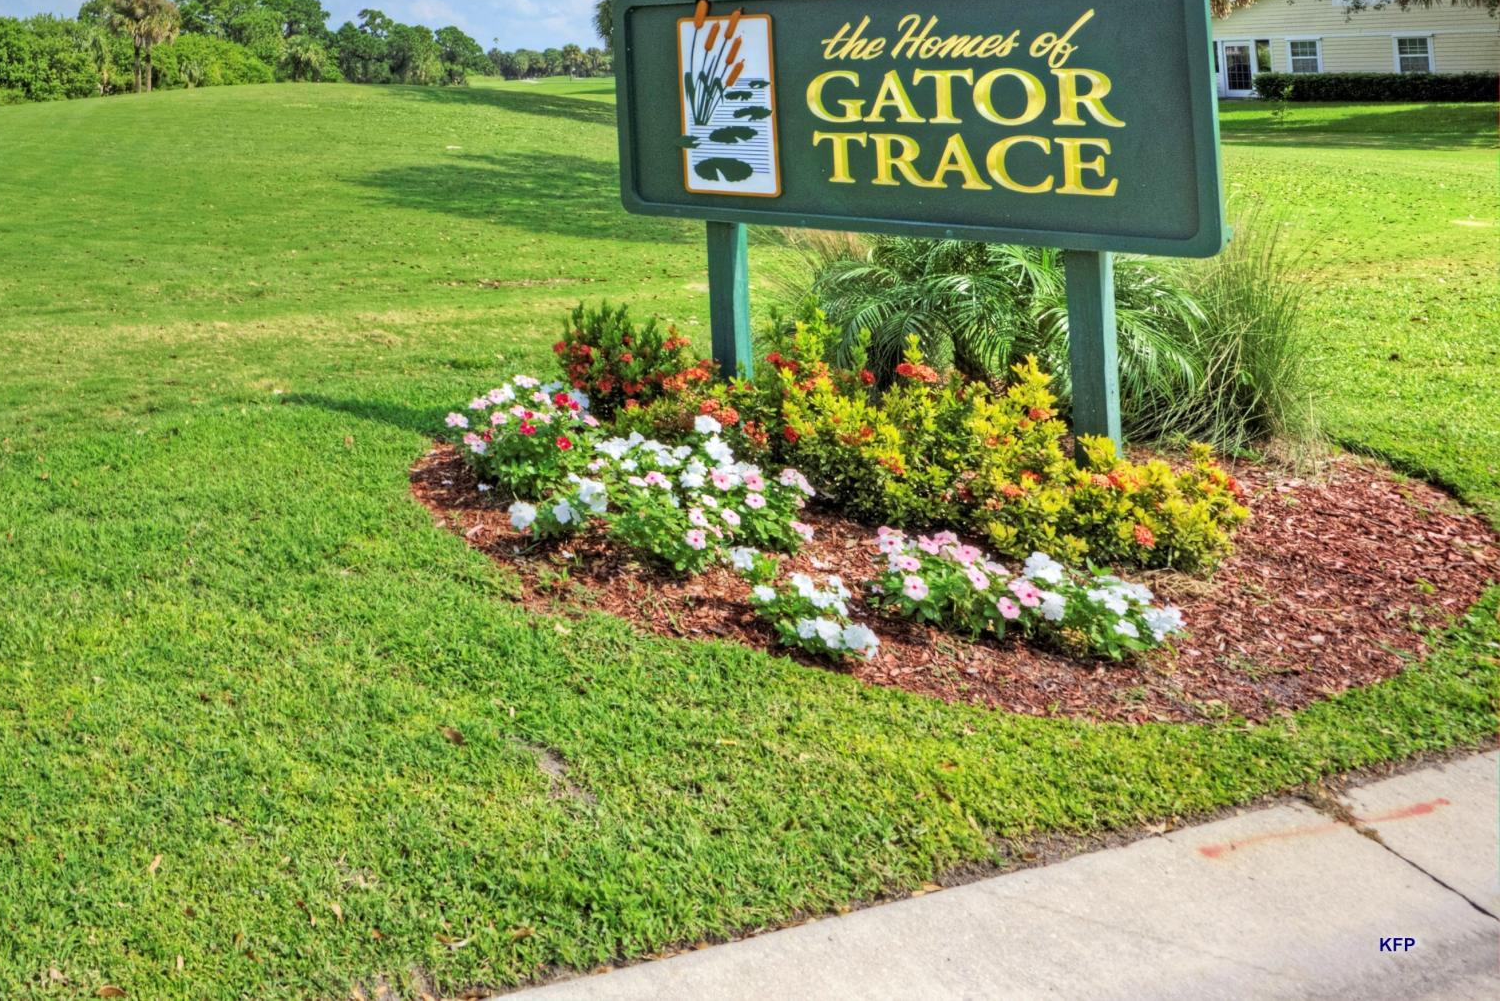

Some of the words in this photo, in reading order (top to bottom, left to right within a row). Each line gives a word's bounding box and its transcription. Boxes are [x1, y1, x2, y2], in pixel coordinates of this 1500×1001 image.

[821, 15, 887, 60] the
[890, 14, 1020, 60] Homes
[1029, 8, 1095, 68] of
[806, 68, 1126, 127] GATOR
[813, 131, 1118, 196] TRACE
